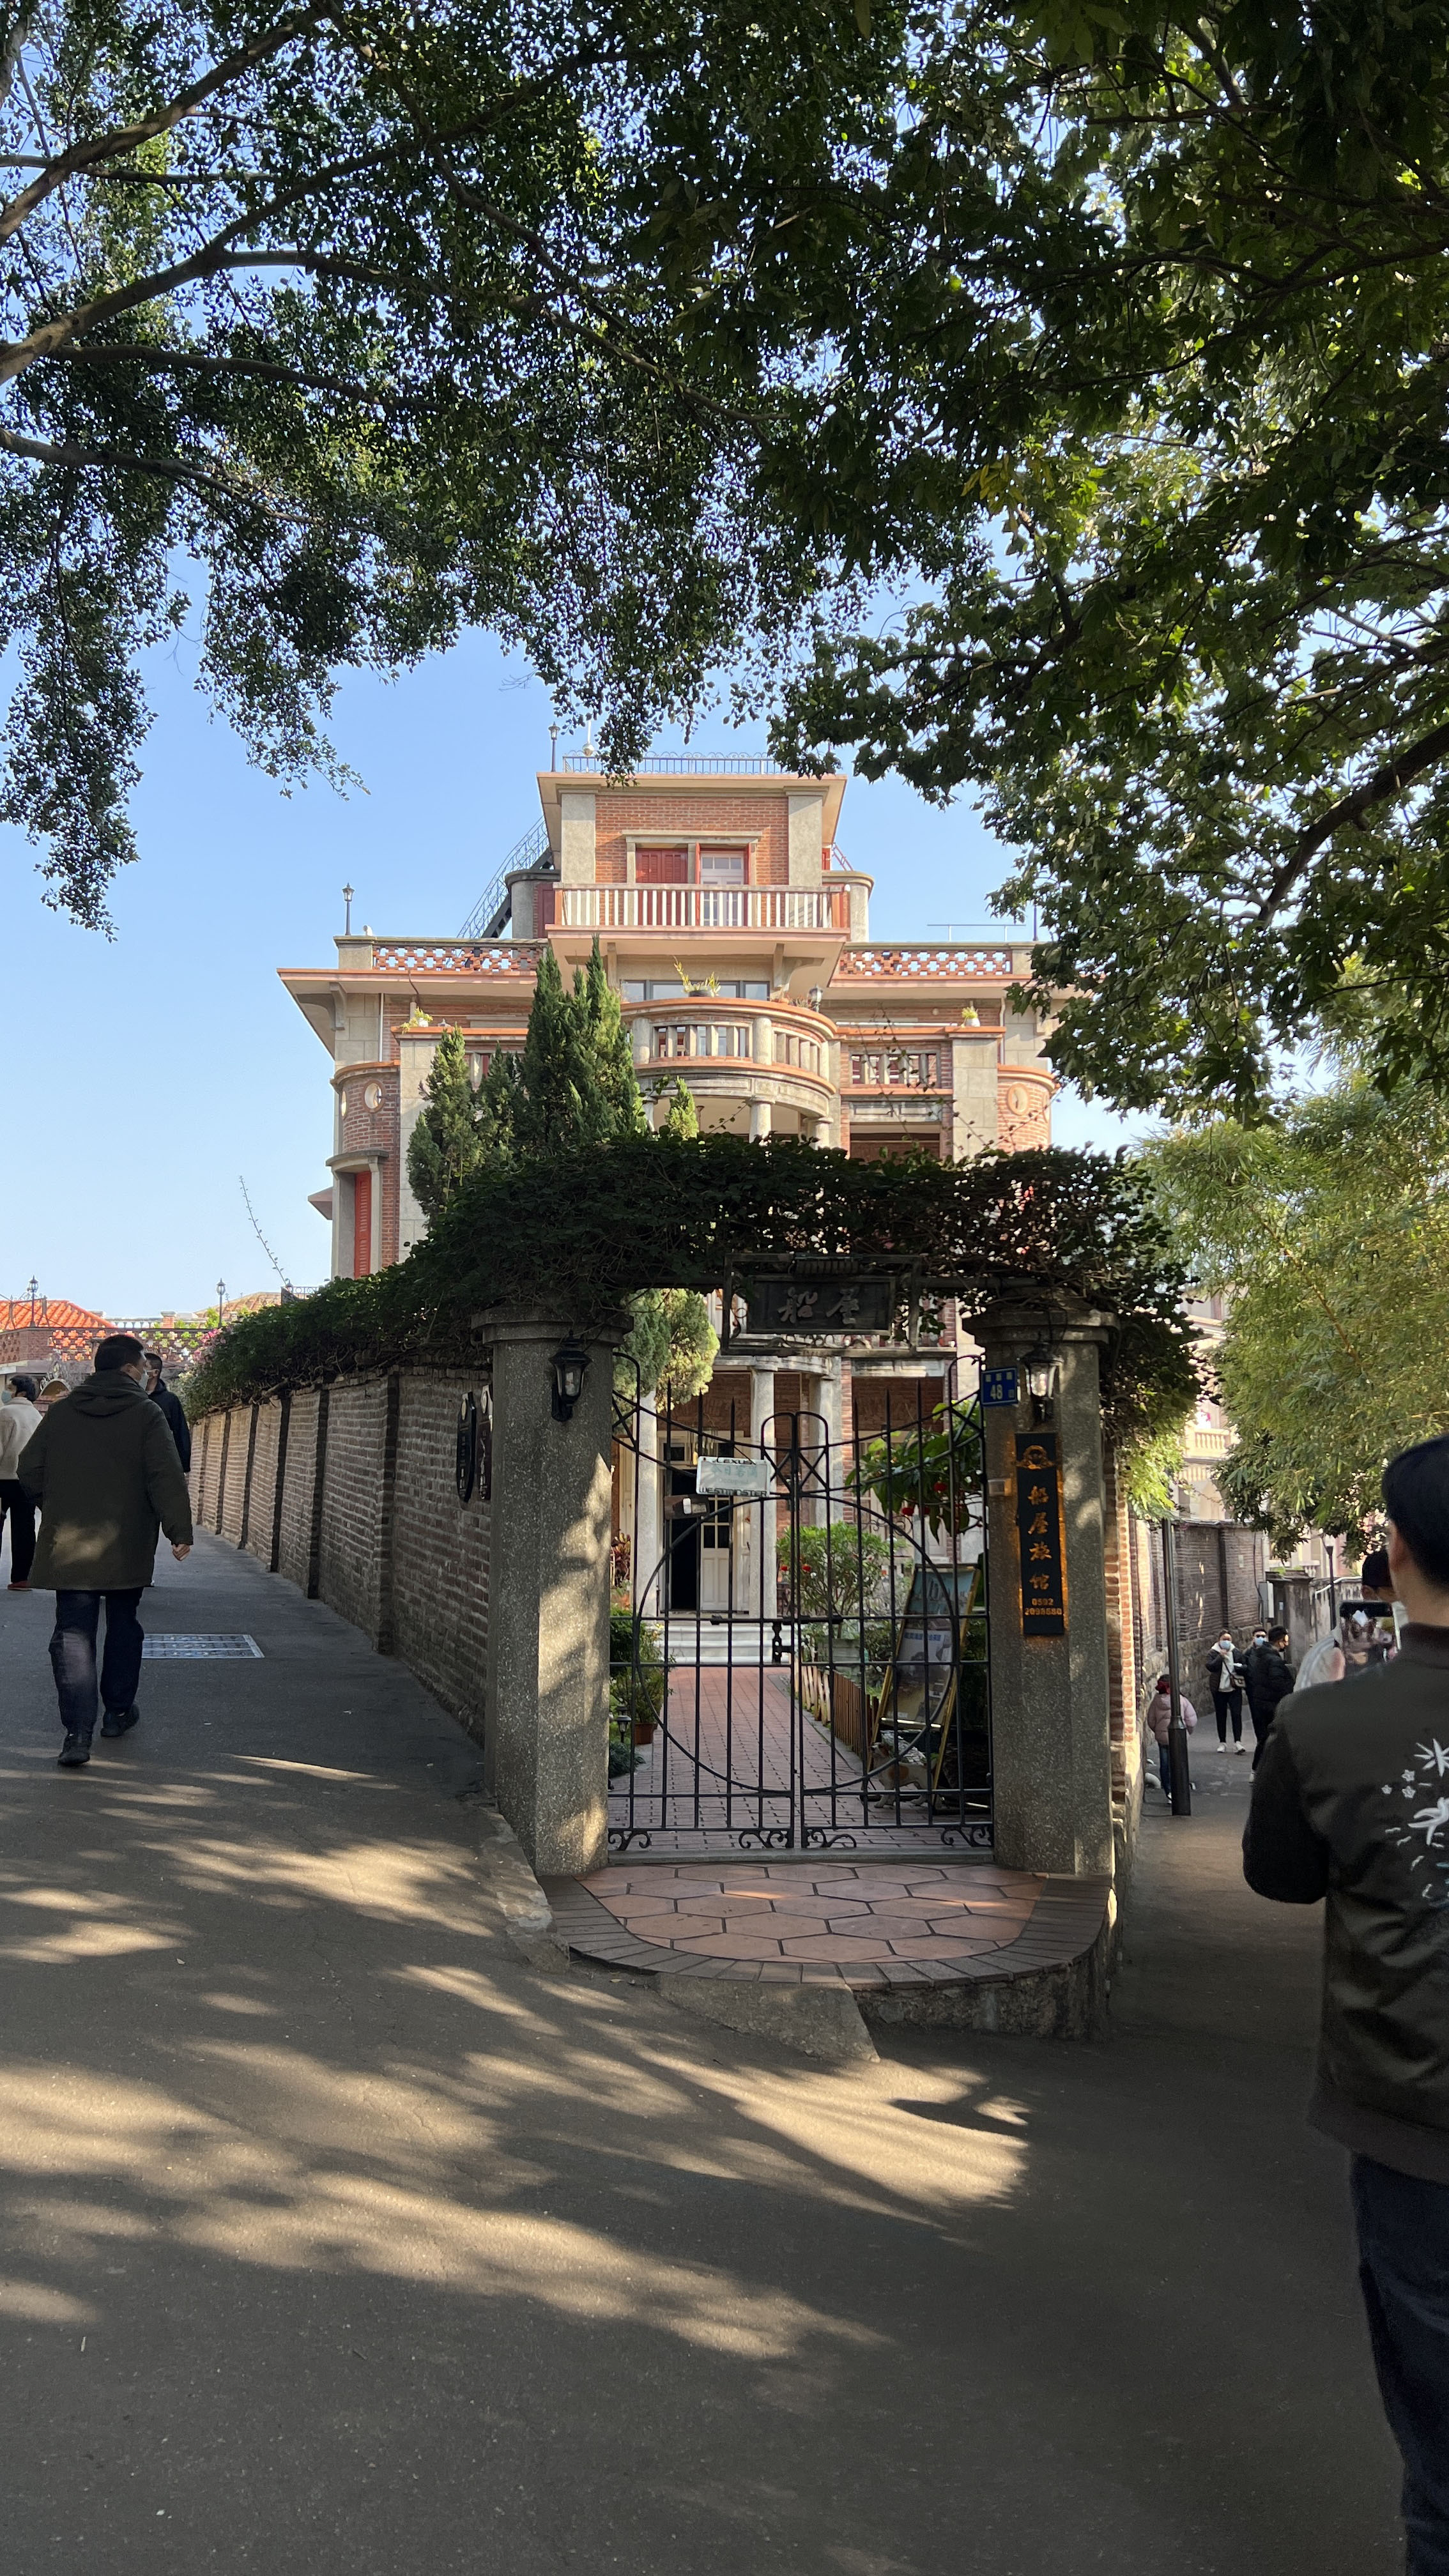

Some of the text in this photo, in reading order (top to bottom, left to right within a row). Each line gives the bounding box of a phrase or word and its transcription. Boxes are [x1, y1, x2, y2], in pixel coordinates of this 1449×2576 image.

[777, 1286, 859, 1325] 船屋
[990, 1384, 1003, 1400] 48
[698, 1487, 767, 1498] WESTMINSTER
